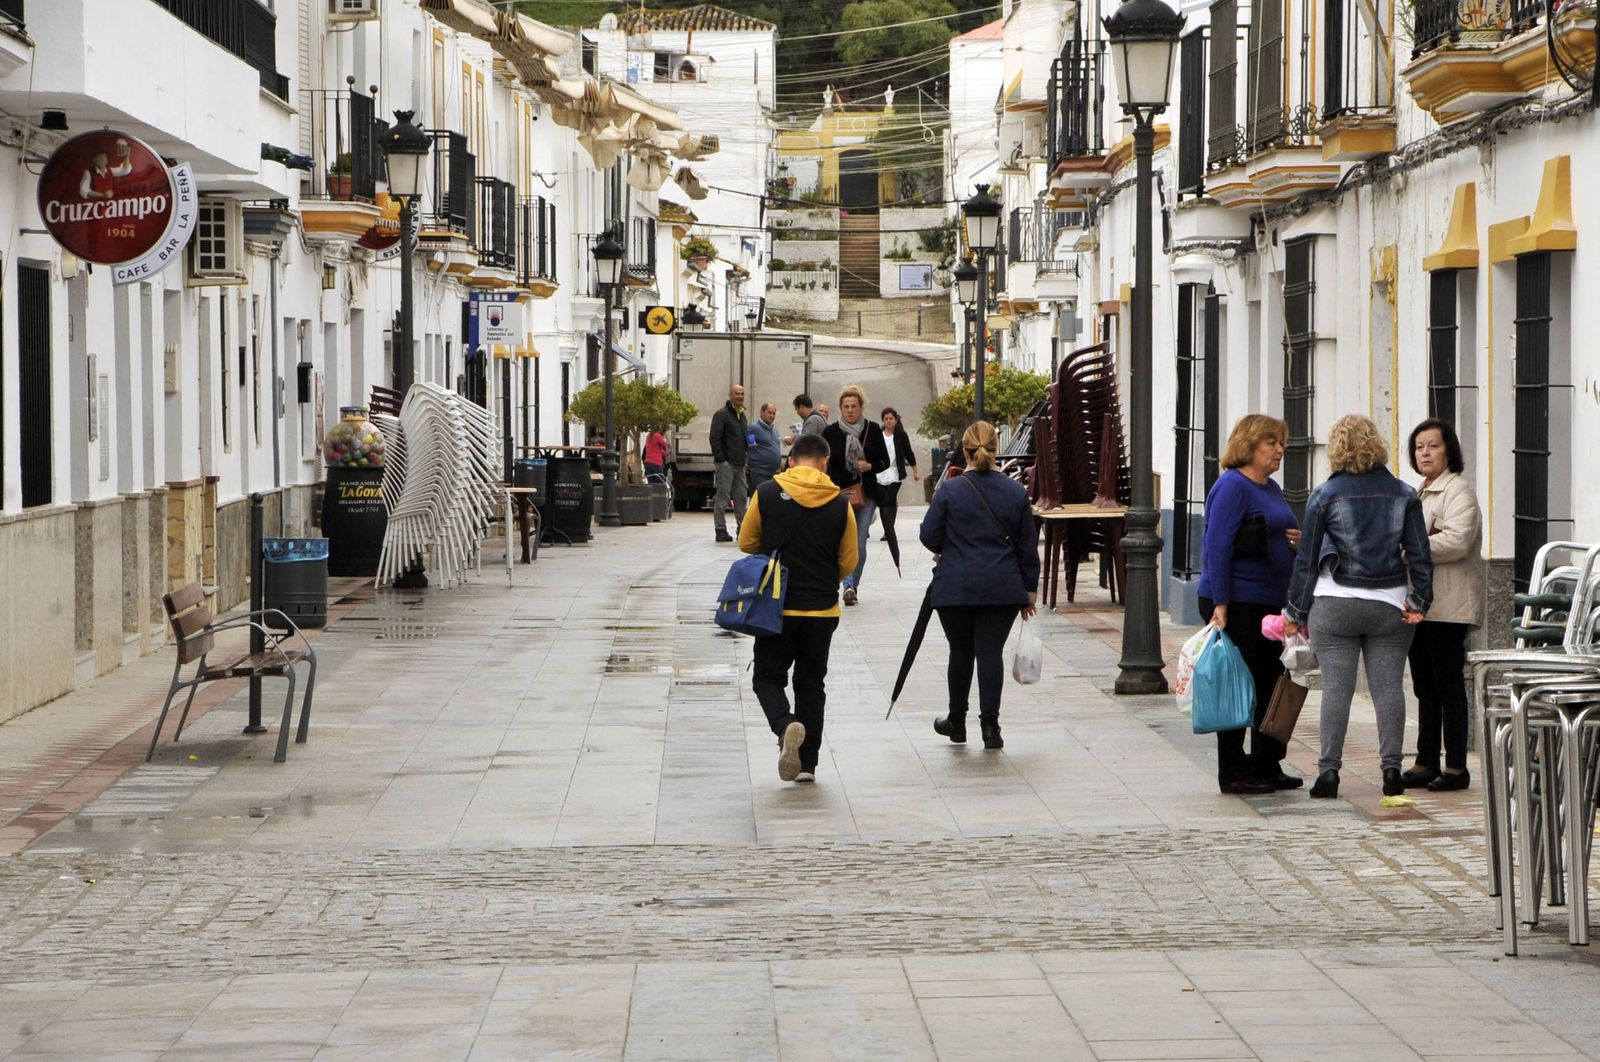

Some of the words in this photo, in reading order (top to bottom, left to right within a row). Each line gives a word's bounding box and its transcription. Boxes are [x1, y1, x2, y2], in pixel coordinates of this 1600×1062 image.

[177, 169, 190, 202] PEÑA
[46, 194, 167, 224] Cruzcampo
[178, 213, 189, 229] LA
[107, 228, 136, 238] 1904
[158, 238, 180, 261] BAR
[117, 263, 150, 279] CAFE
